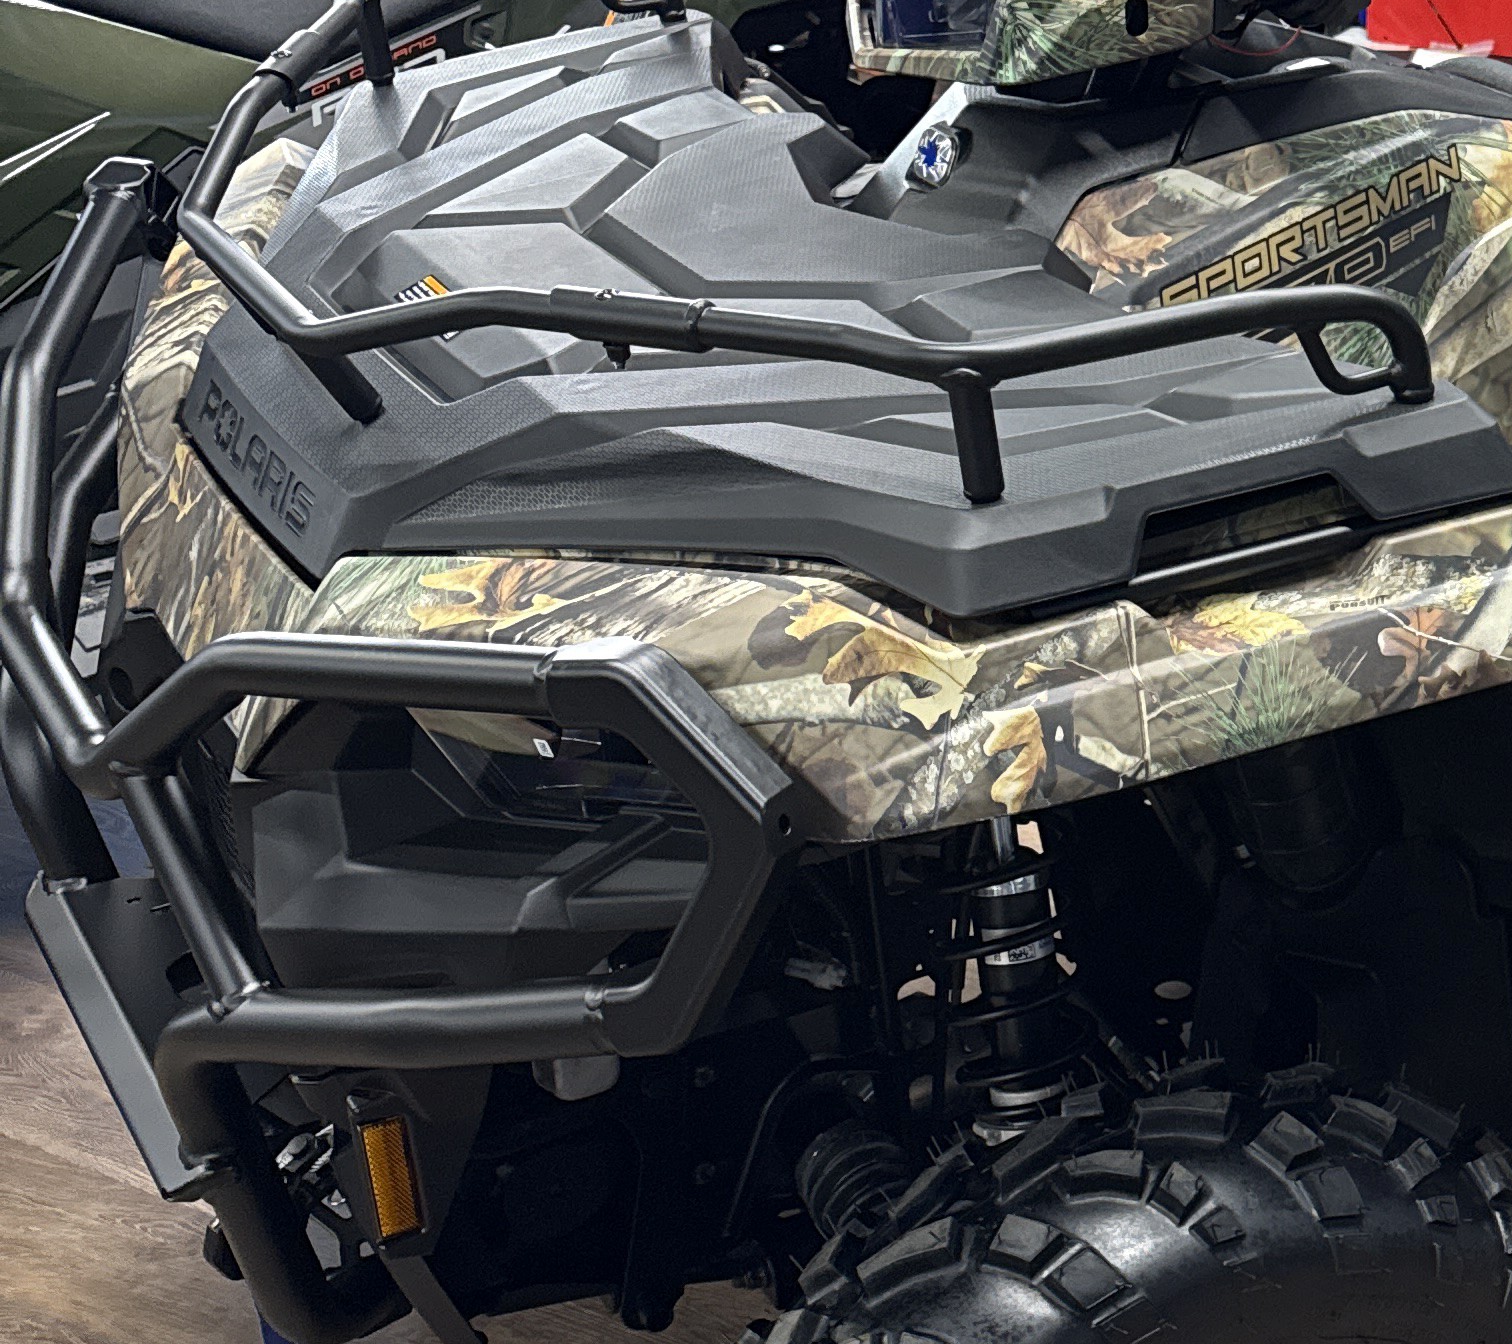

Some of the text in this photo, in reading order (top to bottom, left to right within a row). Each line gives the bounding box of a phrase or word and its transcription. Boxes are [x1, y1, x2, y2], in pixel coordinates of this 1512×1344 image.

[311, 77, 341, 98] ON
[349, 34, 437, 80] DAND
[1160, 144, 1462, 307] SPORTSMAN
[1389, 214, 1436, 254] EFI
[198, 378, 318, 538] POLARIS
